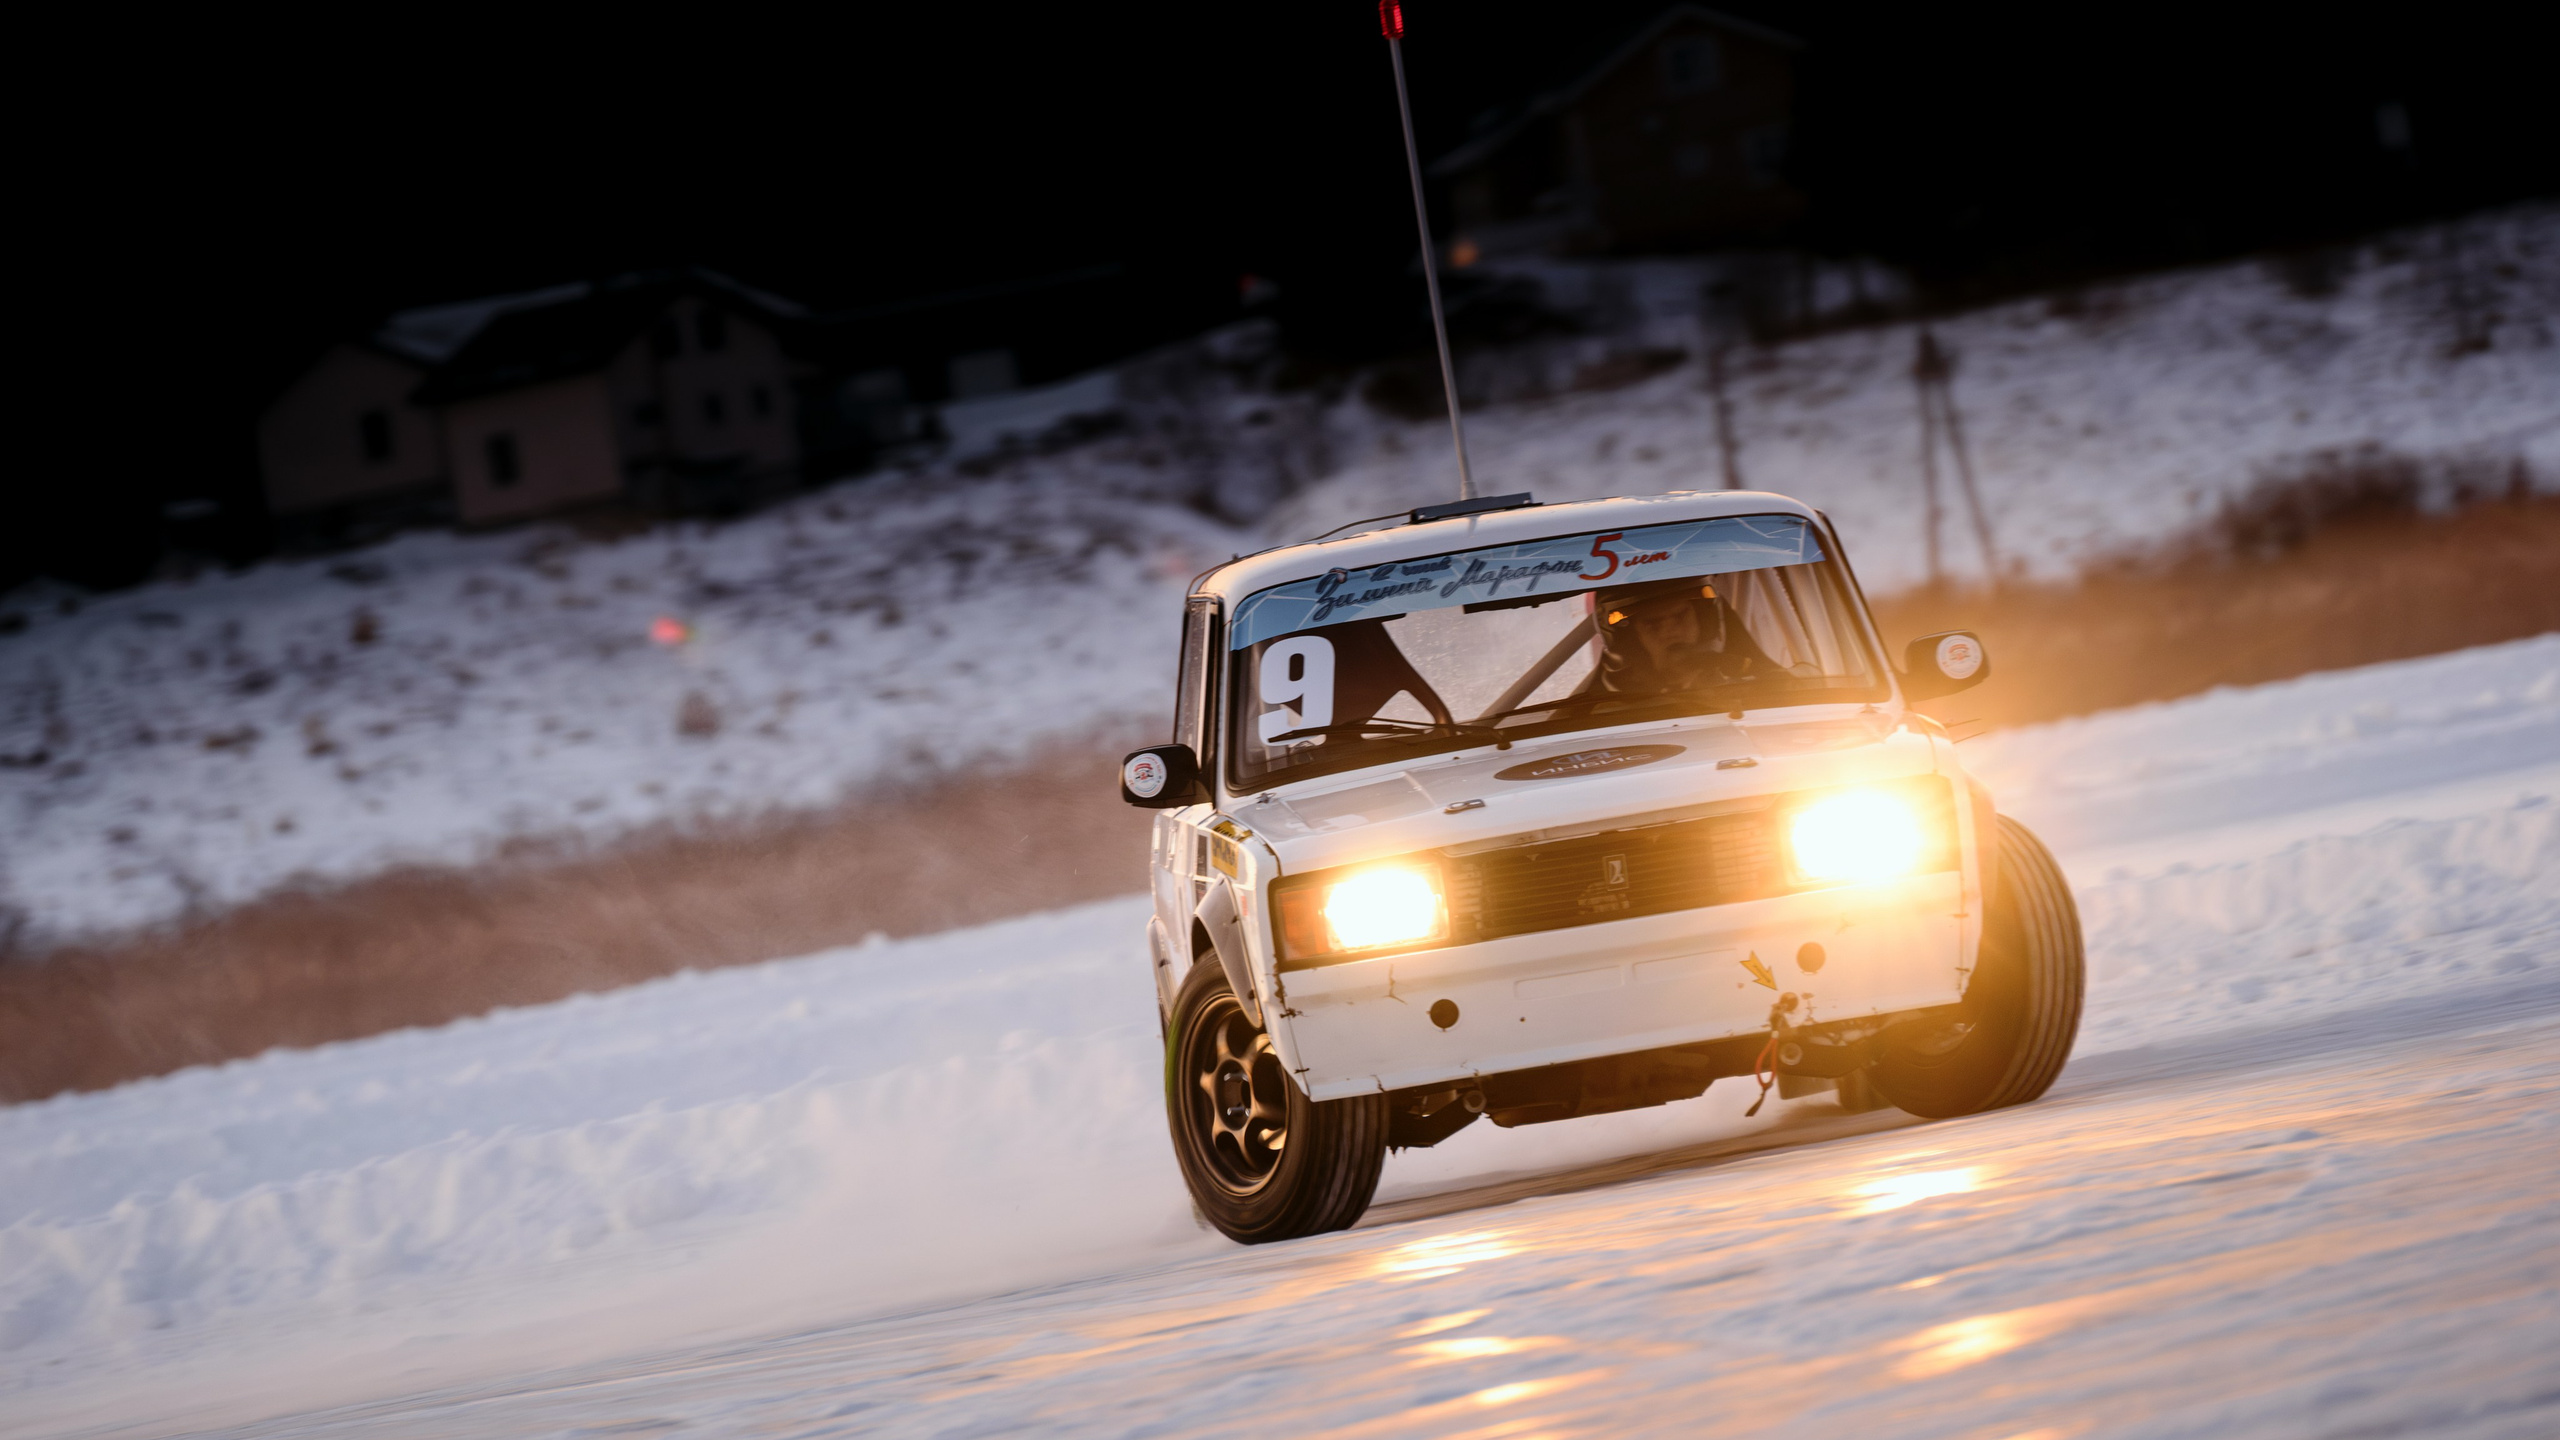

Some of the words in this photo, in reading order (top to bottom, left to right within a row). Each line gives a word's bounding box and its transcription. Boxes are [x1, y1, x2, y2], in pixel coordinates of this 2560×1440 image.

[1313, 568, 1438, 622] Зимний
[1440, 558, 1583, 598] Марафон
[1578, 533, 1623, 581] 5
[1623, 551, 1672, 568] лет
[1258, 635, 1336, 748] 9
